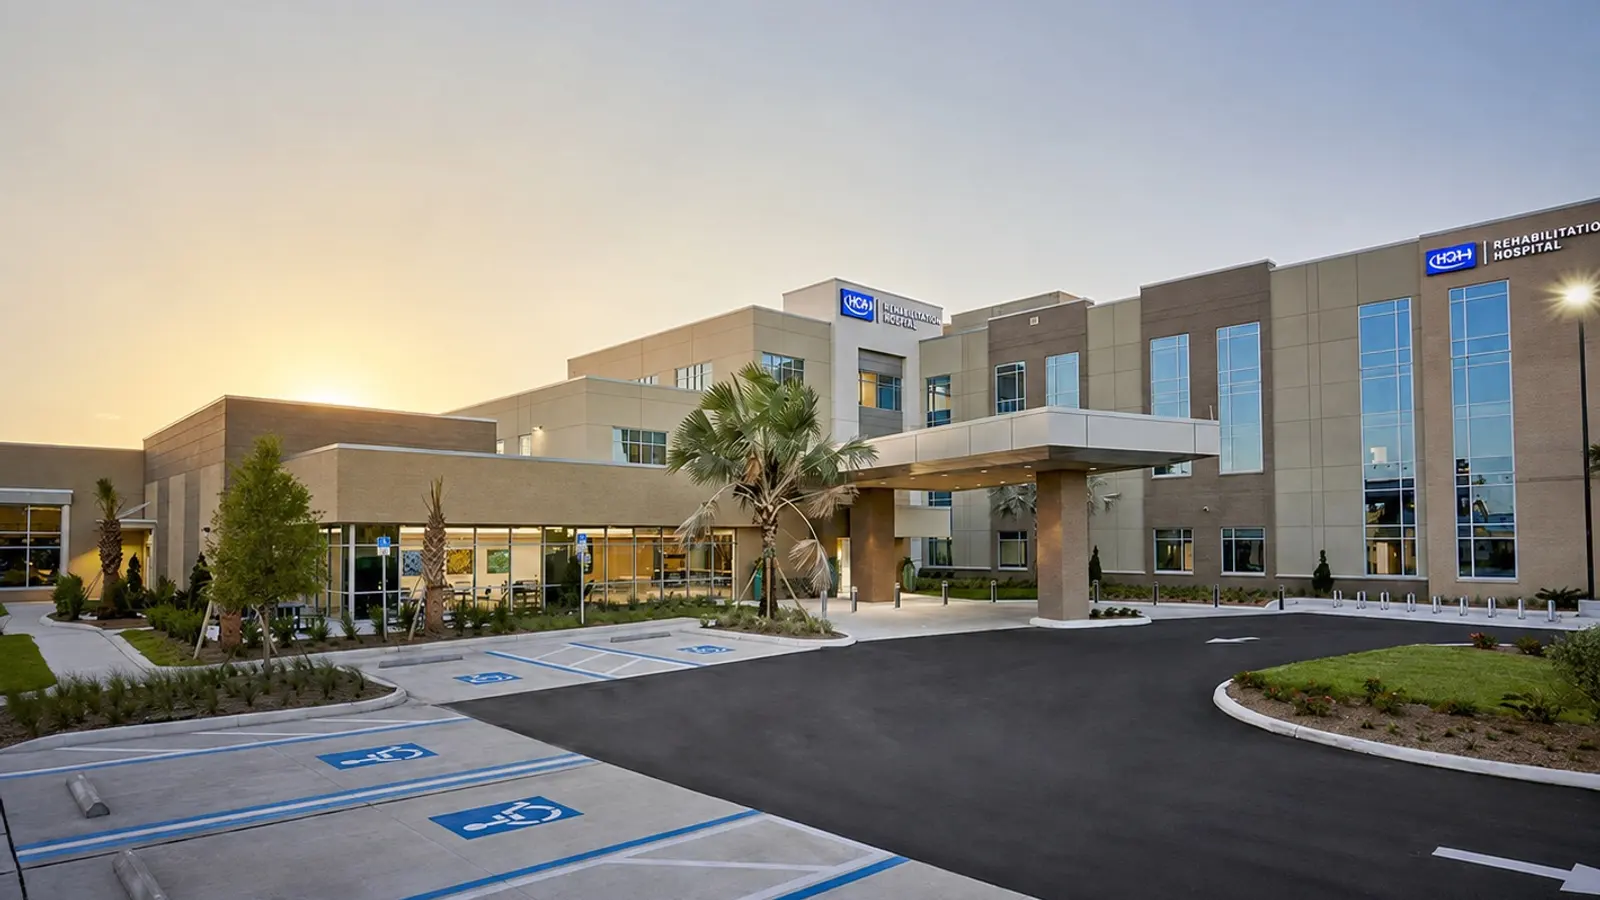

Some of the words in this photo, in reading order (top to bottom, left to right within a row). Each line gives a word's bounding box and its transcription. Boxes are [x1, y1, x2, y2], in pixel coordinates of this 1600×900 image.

[1493, 221, 1600, 249] REHABILITATIO
[1493, 240, 1562, 261] HOSPITAL
[848, 294, 869, 310] HCA
